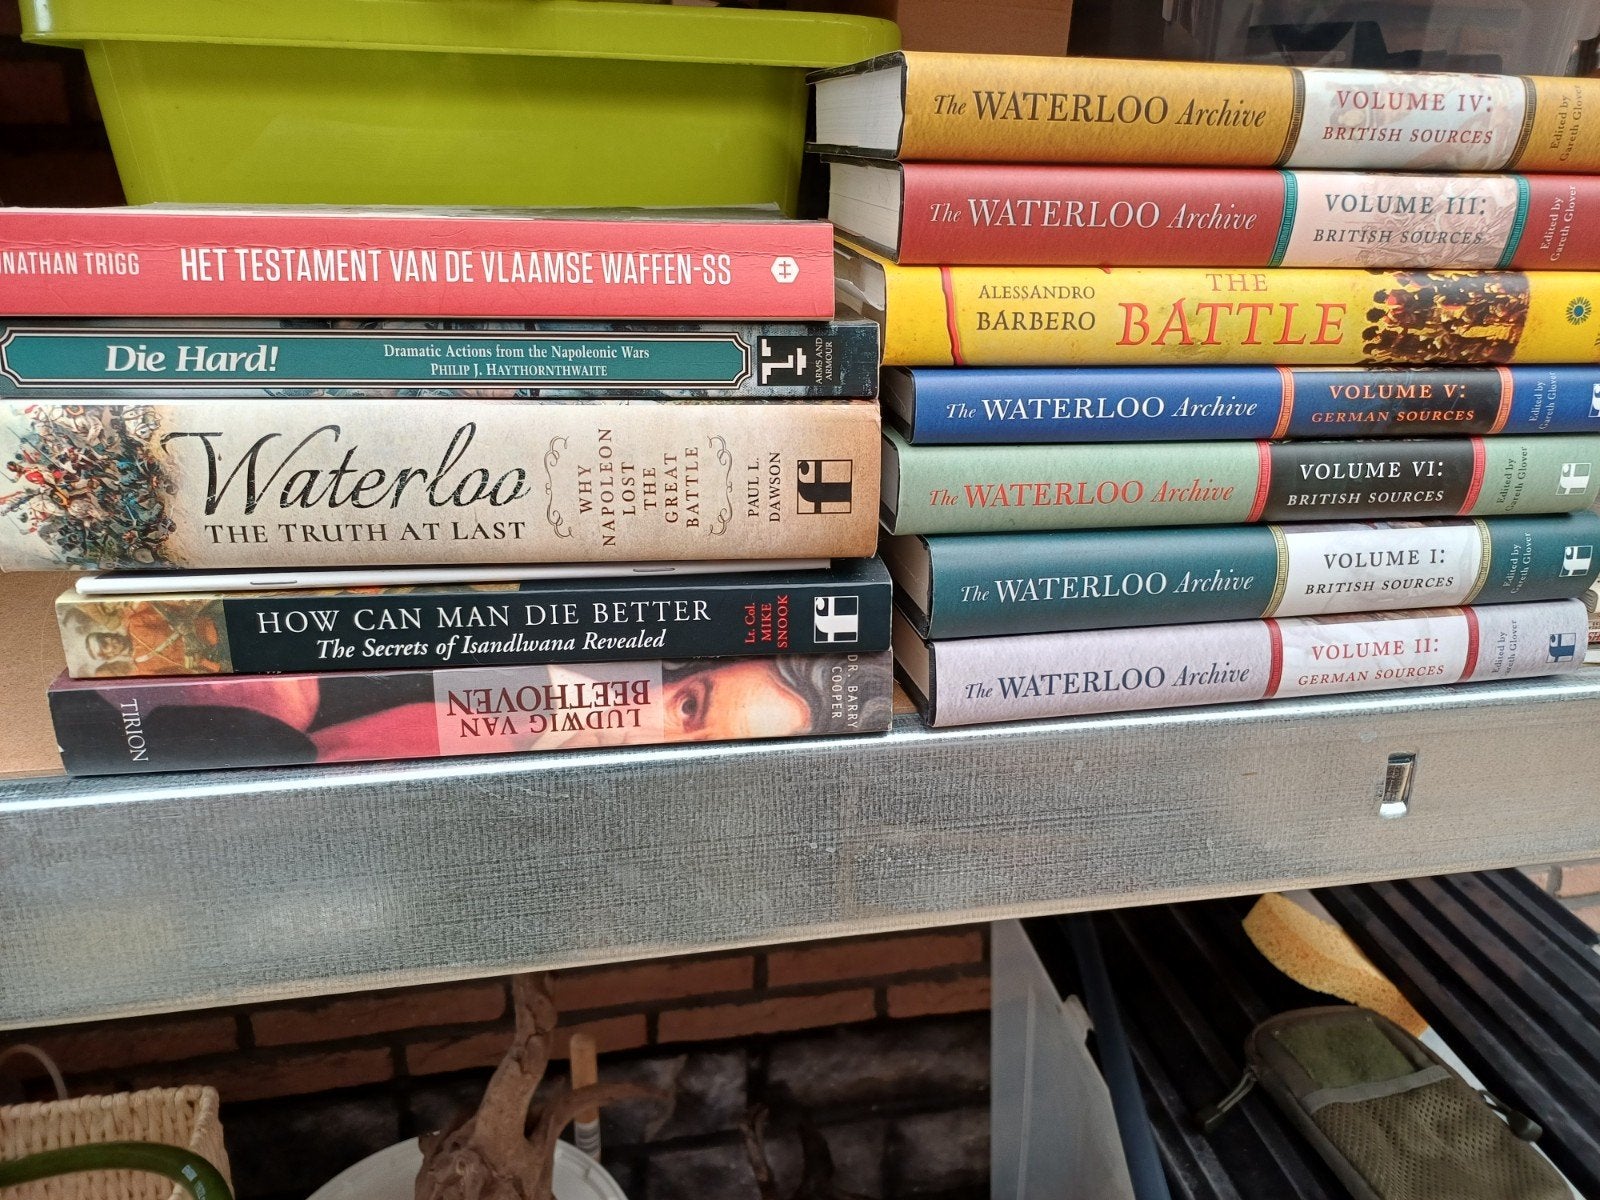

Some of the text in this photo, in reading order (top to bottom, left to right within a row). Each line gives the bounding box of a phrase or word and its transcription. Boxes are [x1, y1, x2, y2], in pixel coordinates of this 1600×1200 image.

[934, 90, 1266, 128] The WATERLOO Archive
[1336, 90, 1492, 113] VOLUME IV:
[1322, 126, 1493, 145] BRITISH SOURCES
[1550, 95, 1571, 149] Edited by
[1560, 85, 1582, 161] Gareth Glover
[929, 199, 1258, 230] The WATERLOO Archive
[1325, 194, 1486, 215] VOLUME III:
[1540, 197, 1564, 250] Edited by
[1550, 185, 1577, 261] Gareth Glover
[1313, 229, 1484, 245] BRITISH SOURCES
[0, 252, 140, 275] NATHAN TRIGG
[181, 248, 731, 286] HET TESTAMENT VAN DE VLAAMSE WAFFEN-SS
[1206, 273, 1268, 292] THE
[978, 285, 1095, 299] ALESSANDRO
[976, 310, 1096, 331] BARBERO
[1116, 298, 1347, 348] BATTLE
[105, 345, 279, 373] Die Hard!
[384, 344, 650, 361] Dramatic Actions from the Napoleonic Wars
[431, 363, 608, 378] PHILIP J. HAYTHORNTHWAITE
[815, 337, 823, 385] ARMS AND
[825, 341, 833, 380] ARMOUR
[946, 396, 1258, 421] The WATERLOO Archive
[1329, 384, 1466, 400] VOLUME V:
[1529, 380, 1546, 422] Edited by
[1538, 372, 1557, 430] Gareth Glover
[1311, 410, 1475, 423] GERMAN SOURCES
[160, 422, 531, 516] Waterloo
[598, 428, 616, 546] NAPOLEON
[663, 452, 678, 523] GREAT
[685, 446, 700, 528] BATTLE
[747, 457, 760, 517] PAUL L.
[769, 452, 781, 522] DAWSON
[1300, 461, 1444, 480] VOLUME VI:
[1497, 458, 1516, 504] Edited by
[1505, 446, 1528, 512] Gareth Glover
[578, 464, 592, 514] WHY
[621, 462, 636, 516] LOST
[643, 467, 657, 510] THE
[929, 479, 1234, 508] The WATERLOO Archive
[1286, 491, 1445, 506] BRITISH SOURCES
[204, 521, 526, 544] THE TRUTH AT LAST
[1324, 548, 1445, 569] VOLUME I:
[1503, 544, 1521, 587] Edited by
[1510, 532, 1532, 594] Gareth Glover
[961, 568, 1254, 603] The WATERLOO Archive
[1304, 576, 1454, 595] BRITISH SOURCES
[257, 599, 711, 635] HOW CAN MAN DIE BETTER
[745, 603, 755, 644] Lt. Col.
[761, 603, 772, 641] MIKE
[777, 595, 789, 648] SNOOK
[1509, 620, 1518, 651] Glover
[316, 629, 666, 661] The Secrets of Isandlwana Revealed
[1312, 638, 1439, 661] VOLUME II:
[831, 666, 843, 718] COOPER
[847, 654, 859, 728] DR. BARRY
[965, 662, 1250, 700] The WATERLOO Archive
[1298, 665, 1445, 686] GERMAN SOURCES
[447, 680, 651, 716] BEETHOVEN
[120, 698, 149, 762] TIRION
[460, 708, 641, 738] LUDWIG VAN
